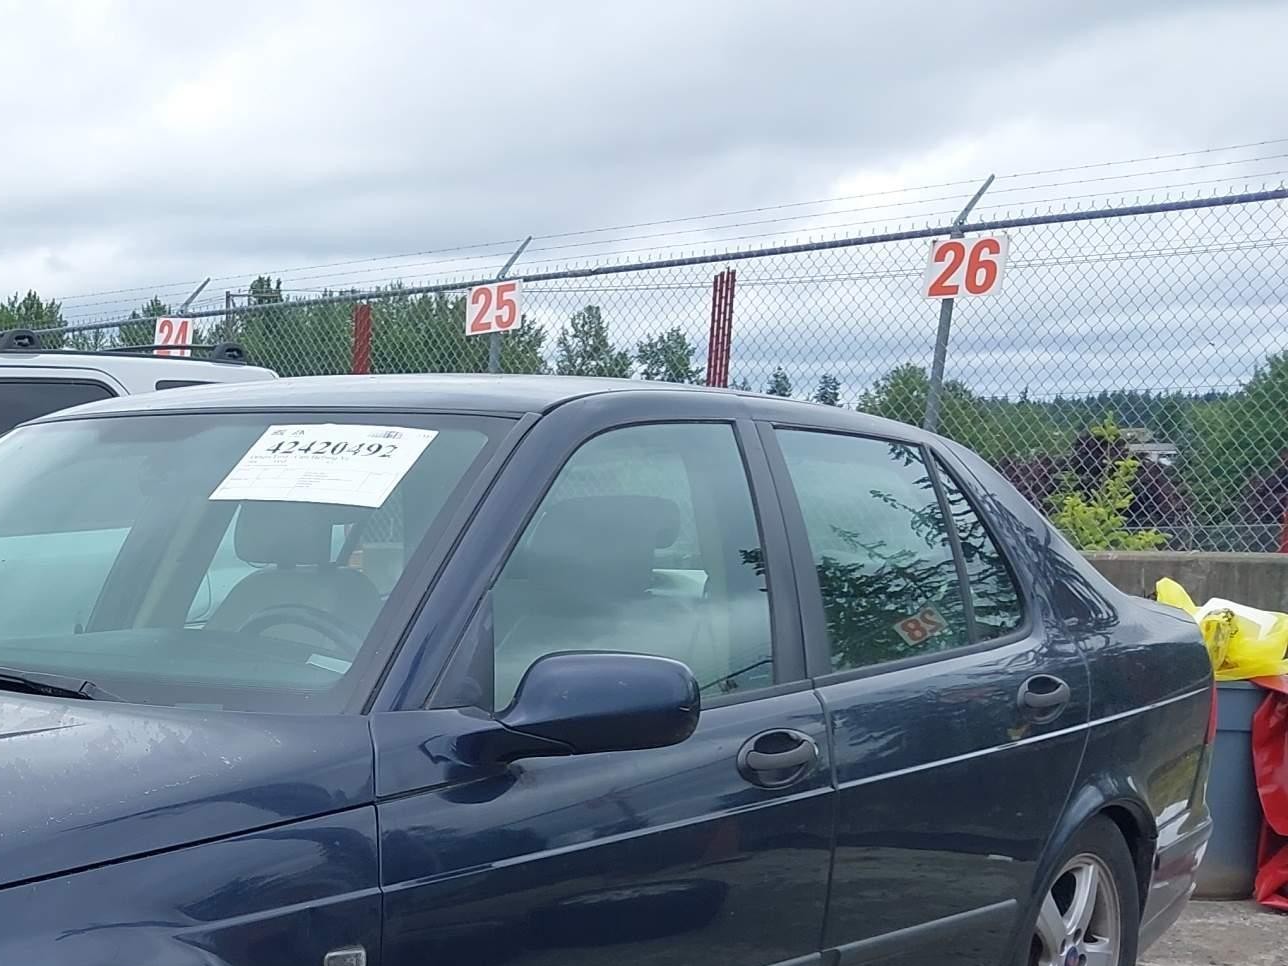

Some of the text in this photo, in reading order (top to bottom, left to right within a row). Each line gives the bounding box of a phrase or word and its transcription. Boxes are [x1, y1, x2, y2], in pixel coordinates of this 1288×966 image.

[928, 239, 1000, 296] 26
[471, 283, 516, 333] 25
[156, 320, 188, 357] 24
[266, 440, 398, 458] 42420492
